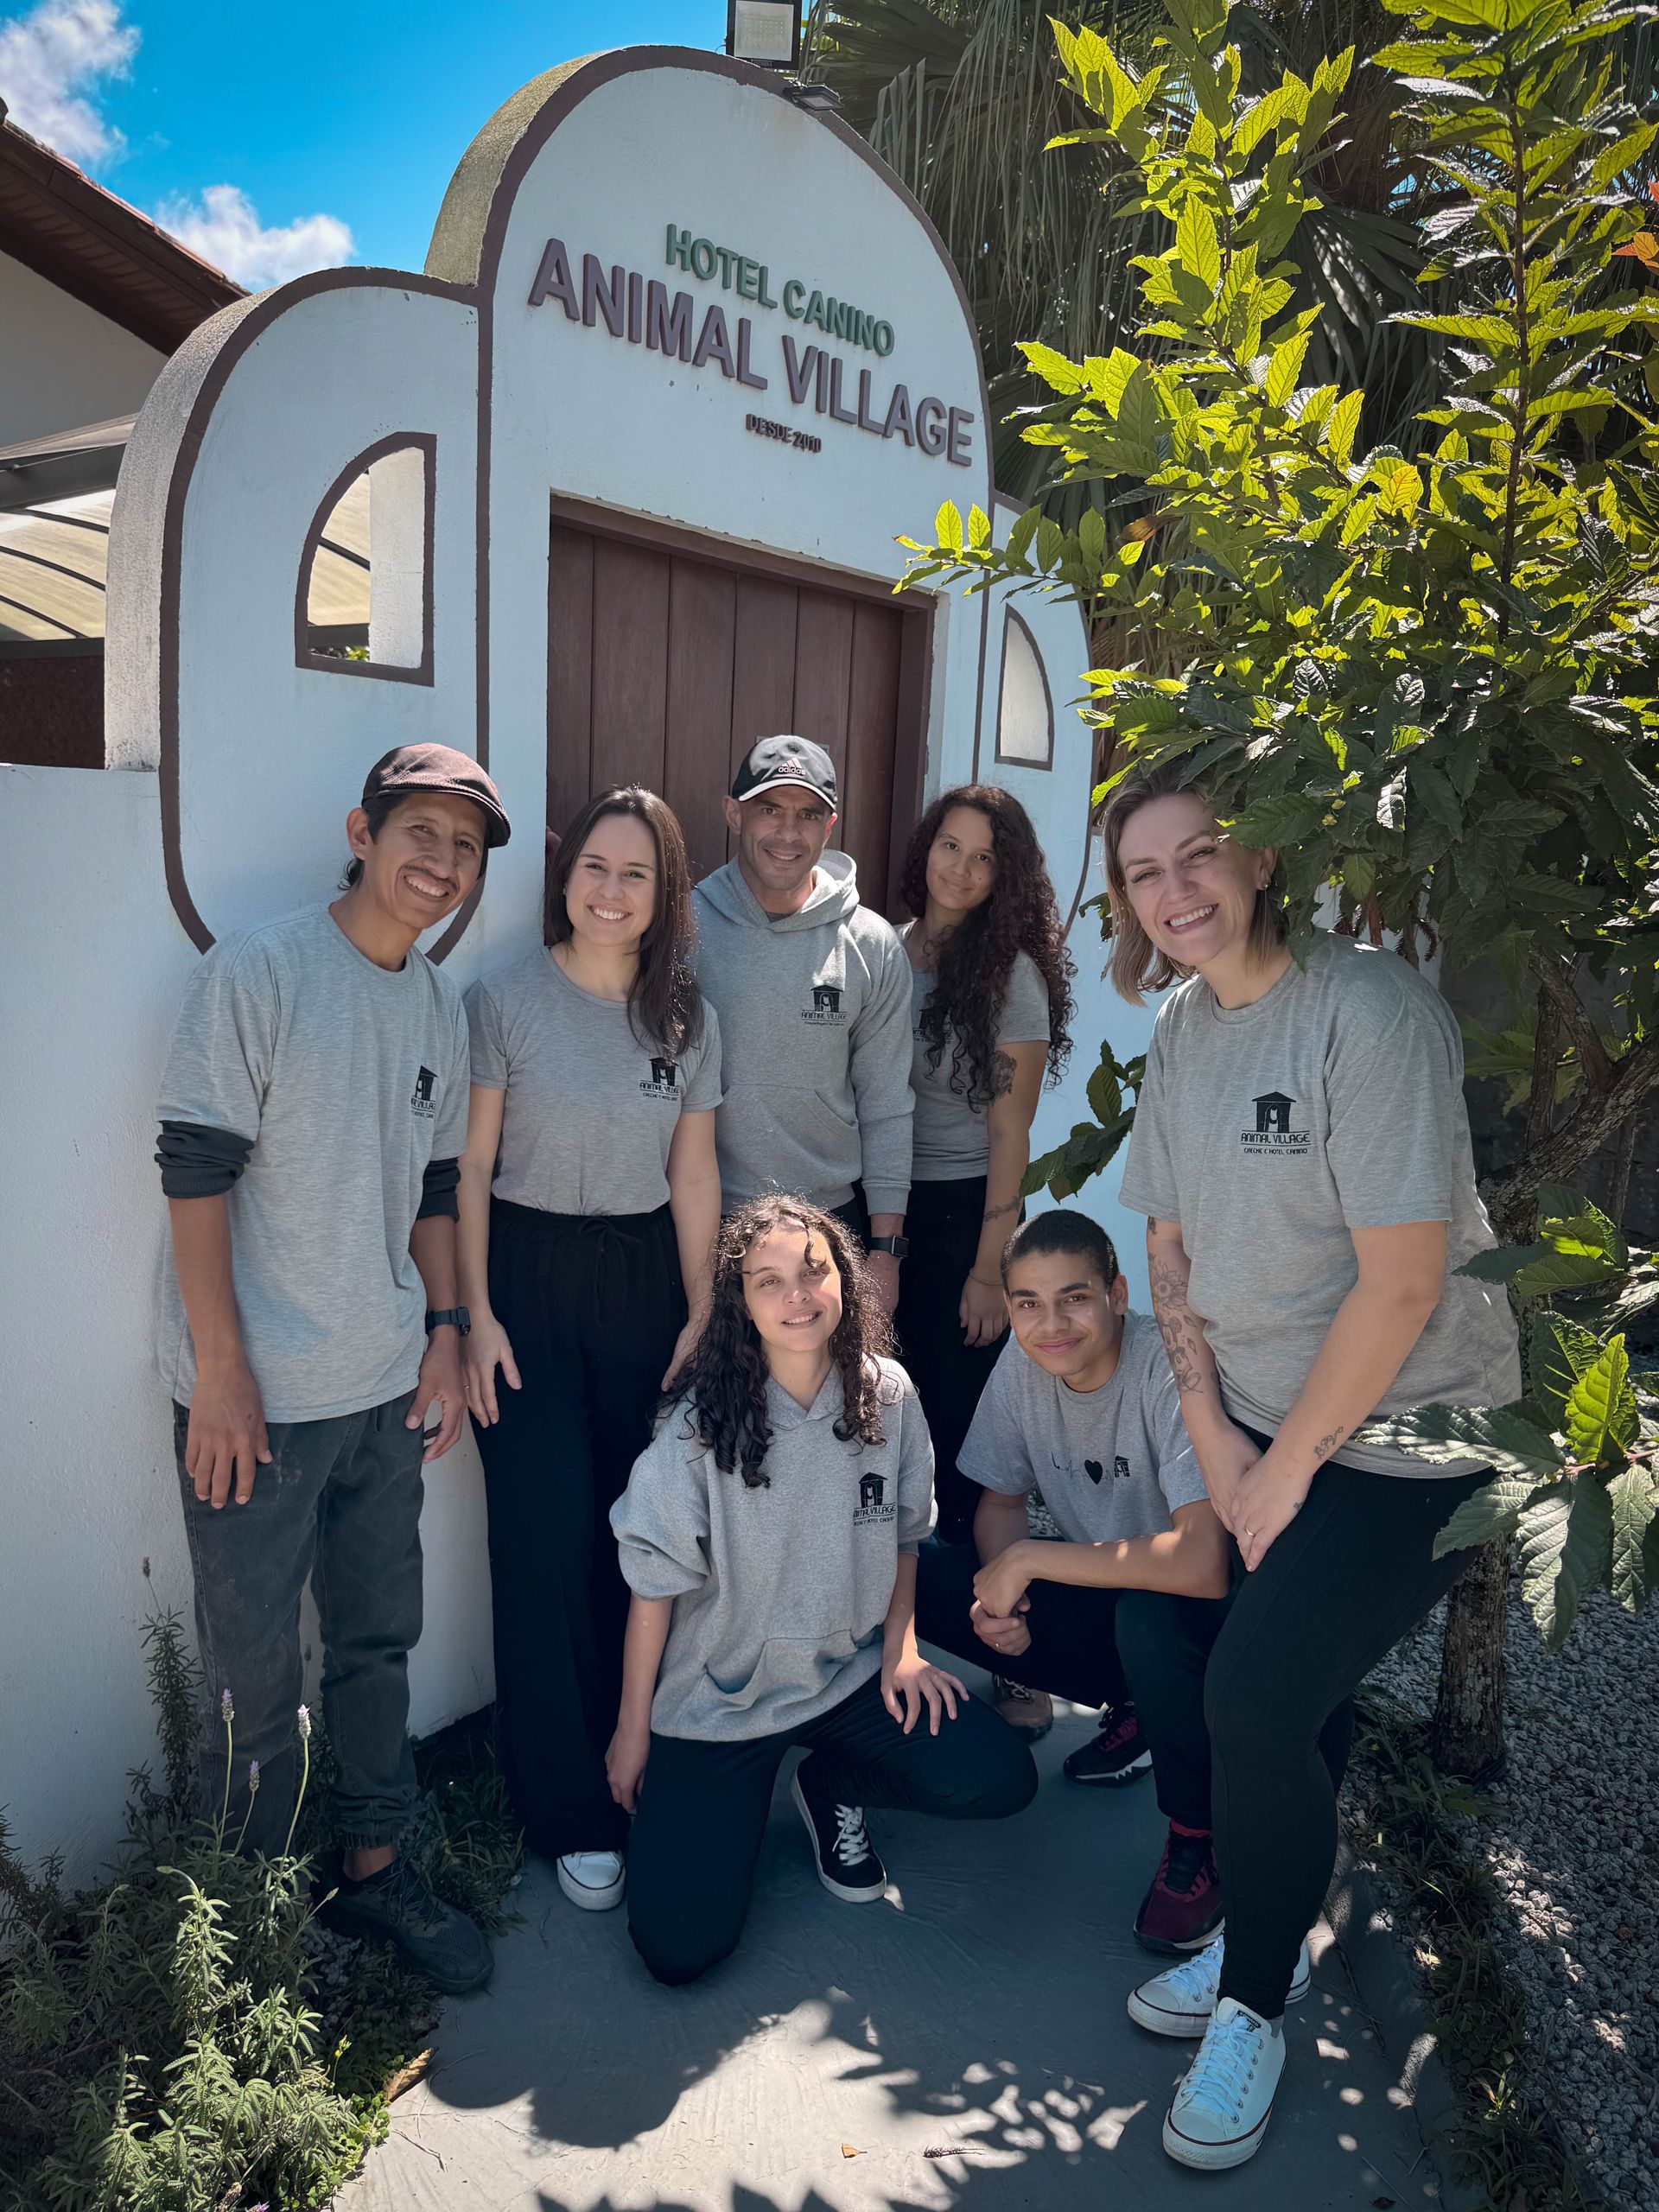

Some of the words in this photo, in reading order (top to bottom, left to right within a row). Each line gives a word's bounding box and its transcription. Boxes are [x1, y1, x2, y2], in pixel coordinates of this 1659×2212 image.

[665, 223, 778, 309] HOTEL
[783, 279, 895, 357] CANINO
[527, 238, 768, 391] ANIMAL
[781, 334, 976, 467] VILLAGE
[746, 413, 792, 443] DESDE
[792, 430, 822, 454] 2010
[1241, 1133, 1271, 1143] ANIMAL
[1272, 1133, 1311, 1144] VILLAGE
[870, 1504, 896, 1515] VILLAGE
